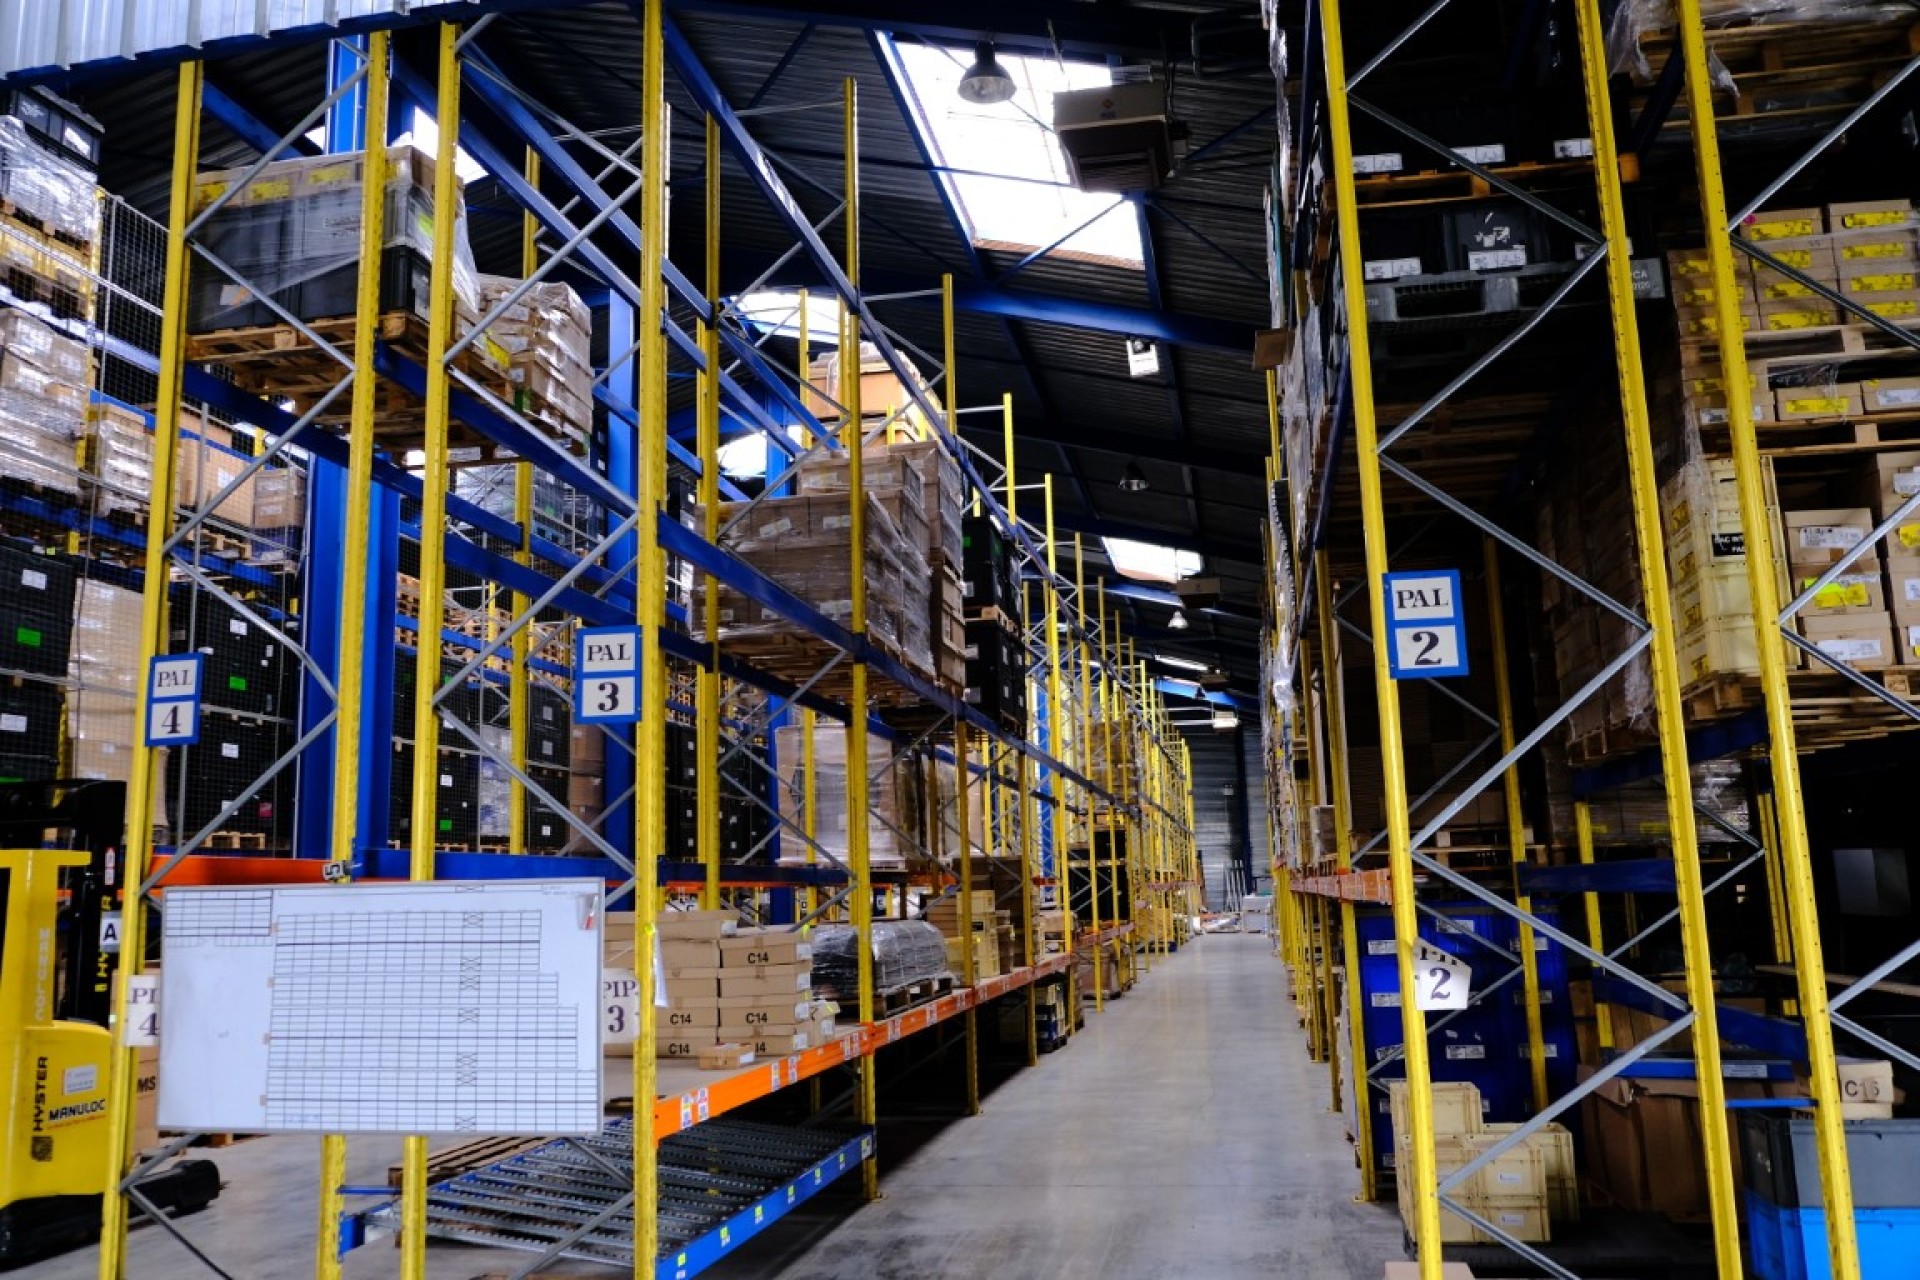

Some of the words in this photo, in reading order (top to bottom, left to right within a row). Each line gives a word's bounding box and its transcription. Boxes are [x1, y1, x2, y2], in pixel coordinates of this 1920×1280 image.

[1396, 587, 1449, 609] PAL
[587, 643, 631, 662] PAL
[1412, 630, 1442, 666] 2
[157, 669, 192, 688] PAL
[597, 681, 619, 712] 3
[161, 704, 182, 734] 4
[103, 923, 118, 941] A
[747, 952, 769, 965] C14
[1429, 966, 1452, 1000] 2
[138, 1012, 160, 1037] 4
[608, 1004, 625, 1034] 3
[670, 1013, 693, 1025] C14
[745, 1012, 768, 1024] C14
[668, 1043, 691, 1055] C14
[33, 1056, 48, 1132] HYSTER
[49, 1098, 106, 1121] MANULOC
